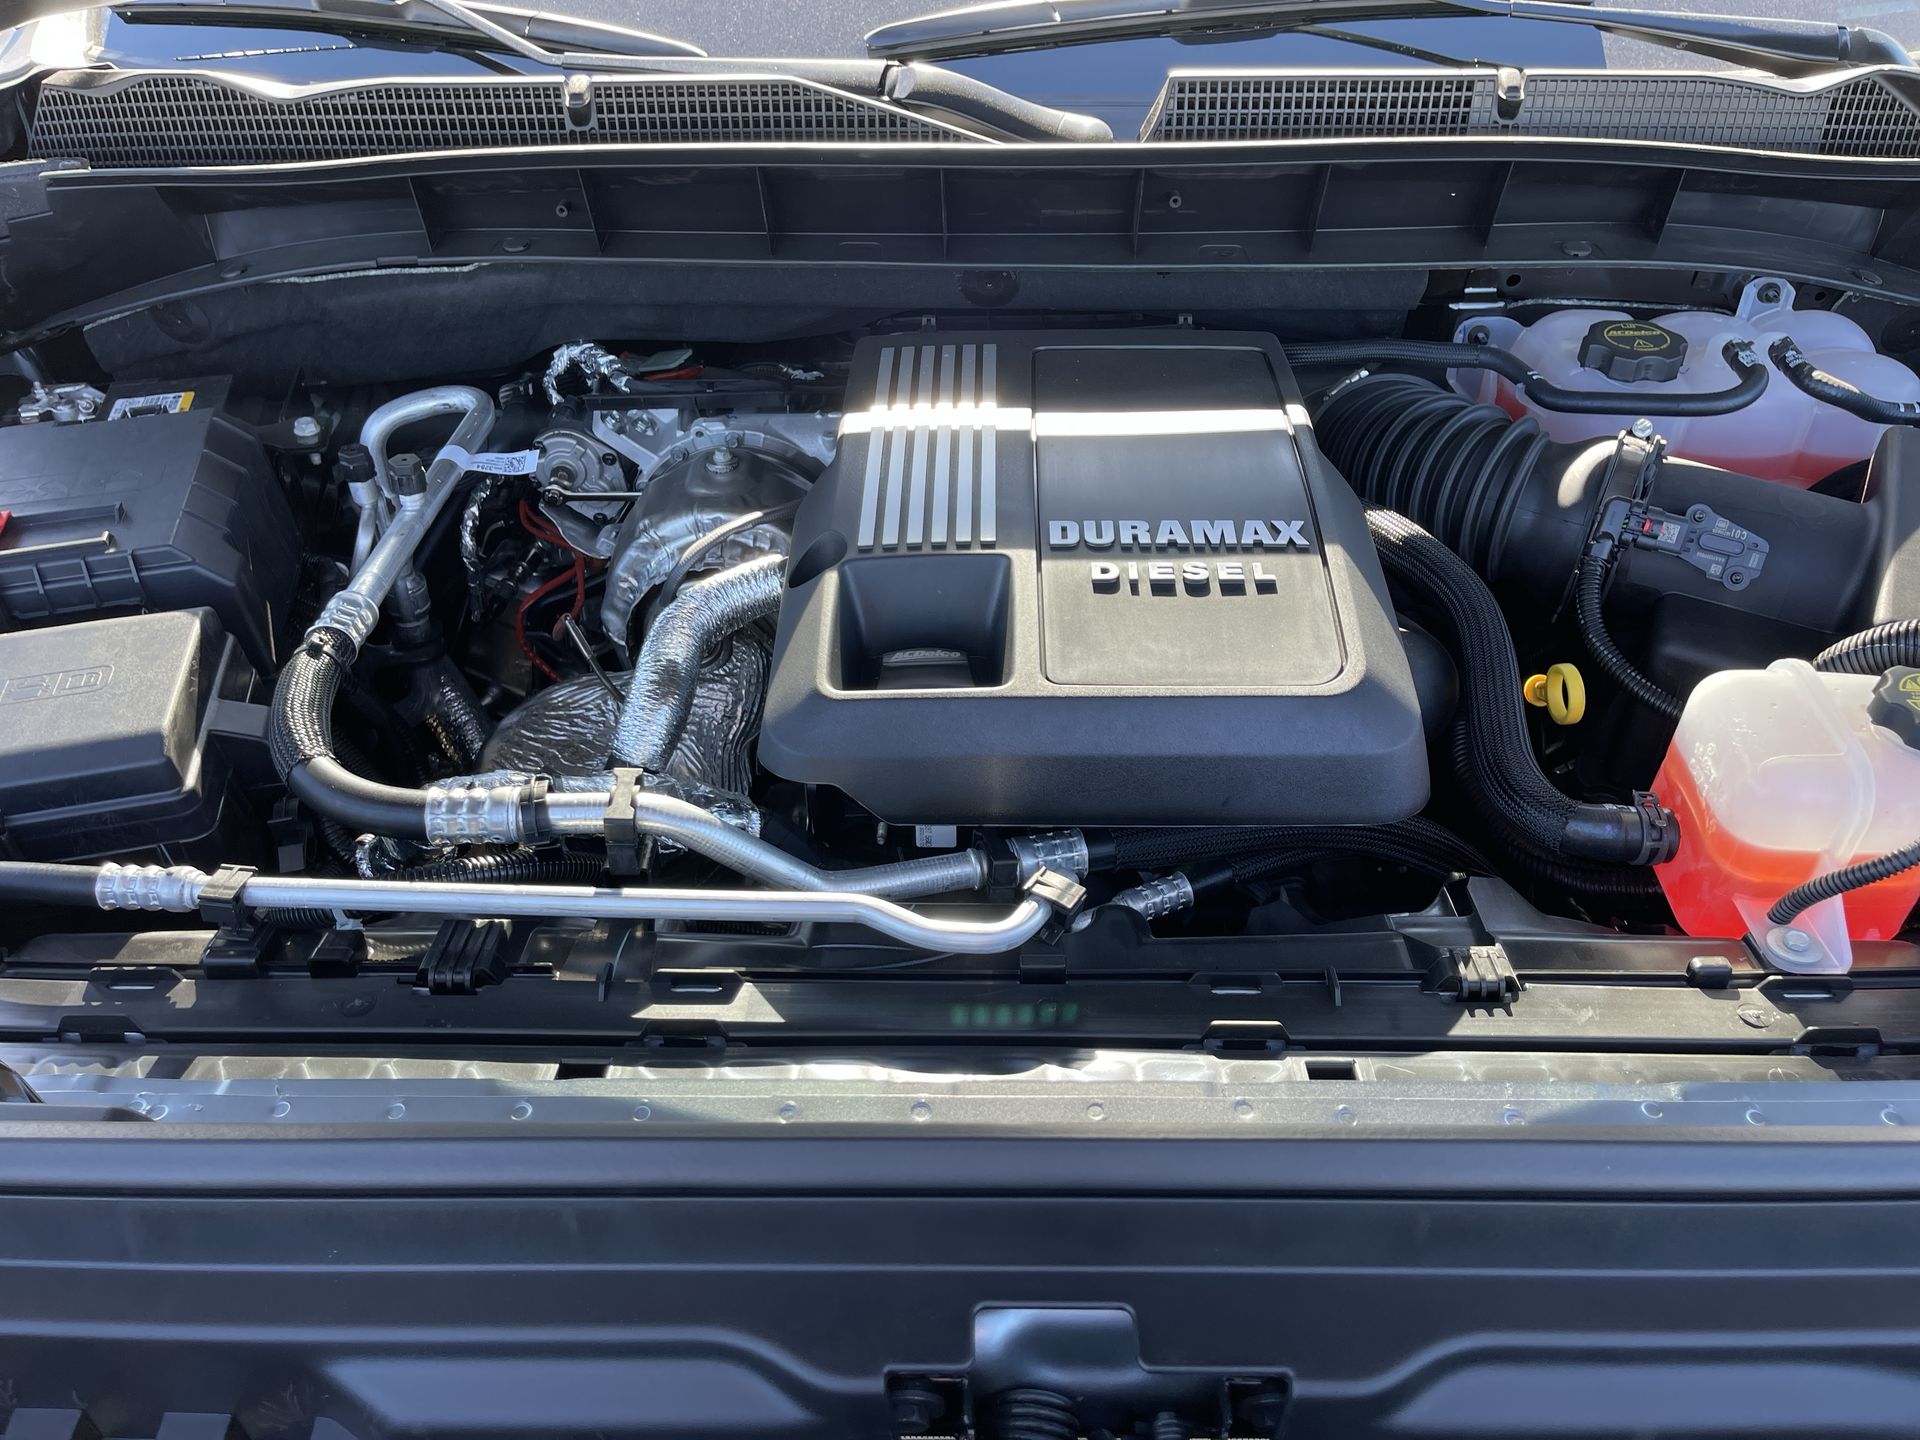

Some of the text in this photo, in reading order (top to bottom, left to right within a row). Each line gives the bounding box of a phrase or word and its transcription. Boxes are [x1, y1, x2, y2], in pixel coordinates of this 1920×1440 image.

[1049, 520, 1310, 548] DURAMAX
[1091, 562, 1277, 584] DIESEL
[889, 650, 961, 662] ACDelco
